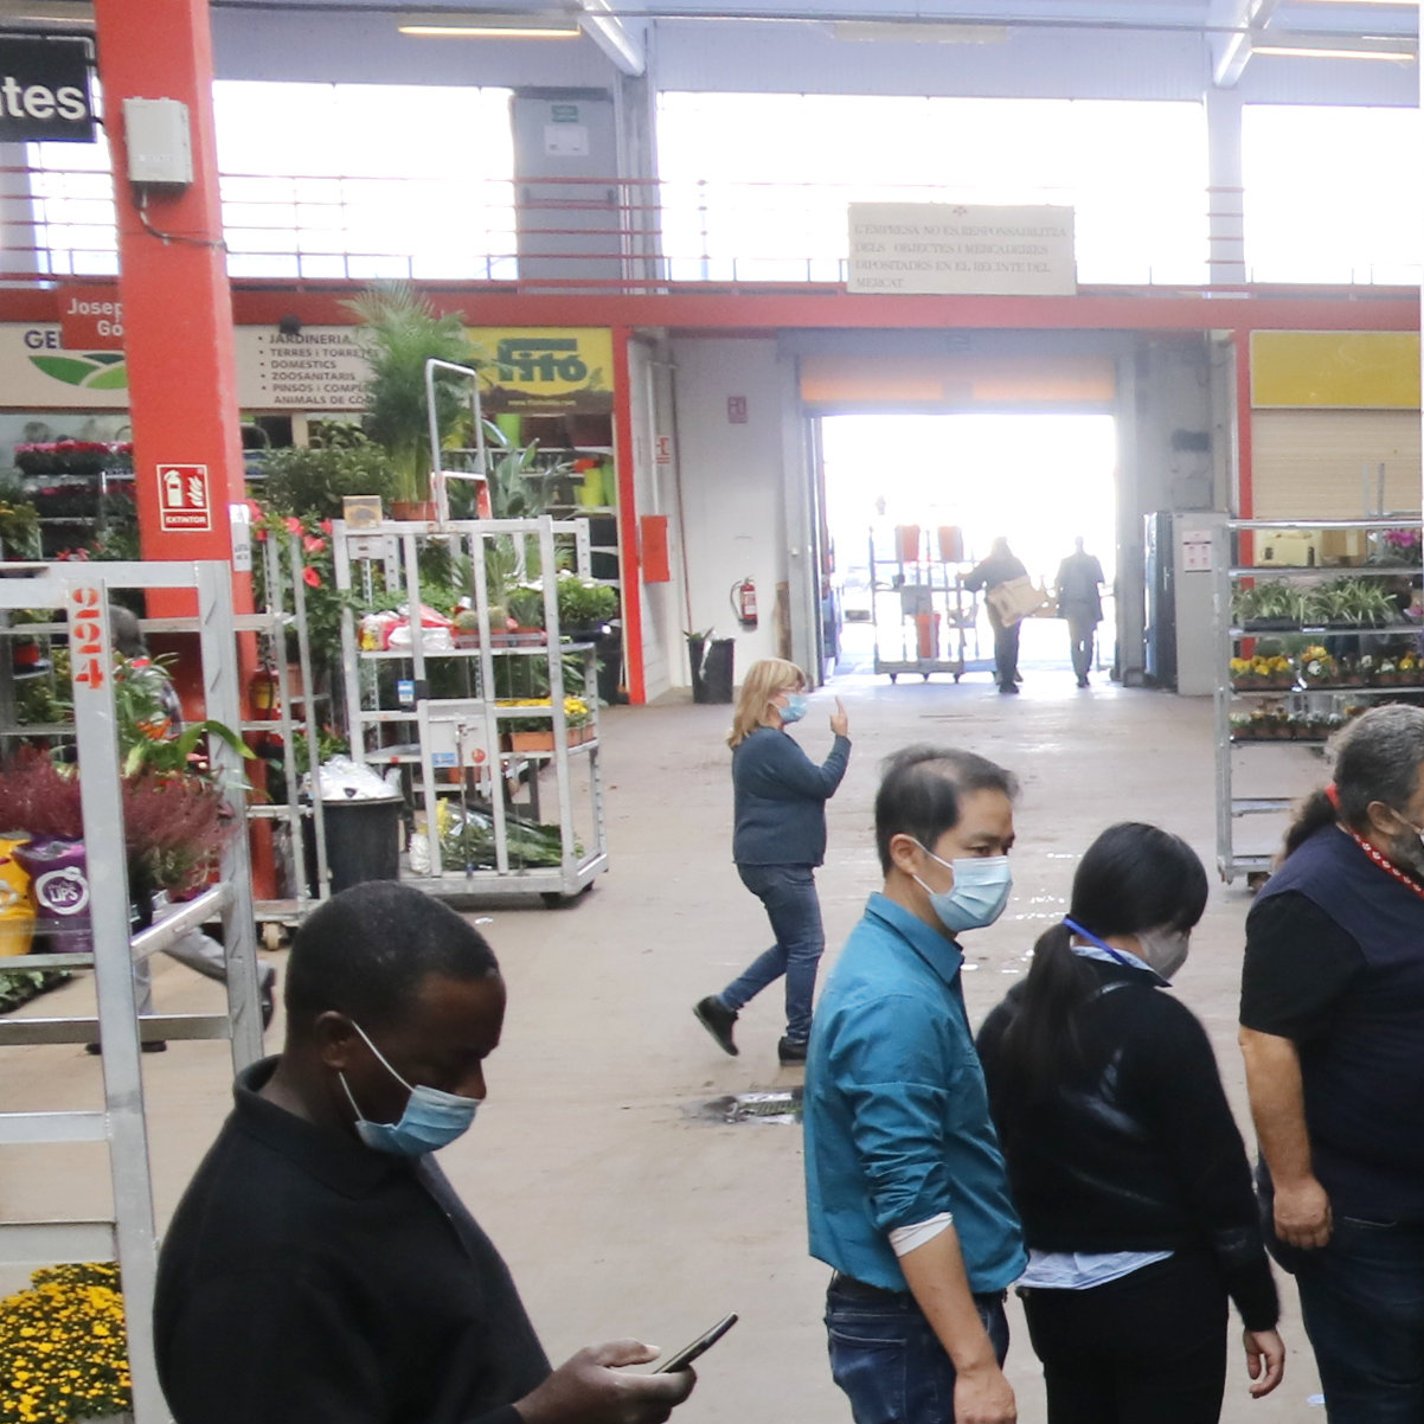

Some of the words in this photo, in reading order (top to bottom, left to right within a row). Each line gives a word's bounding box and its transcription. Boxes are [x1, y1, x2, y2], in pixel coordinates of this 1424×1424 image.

[0, 77, 86, 120] tes
[269, 333, 353, 345] JARDINERIA
[270, 348, 312, 358] TERRES
[271, 371, 356, 381] ZOOSANITARIS
[274, 395, 327, 405] ANIMALS
[165, 516, 207, 524] EXTINTOR
